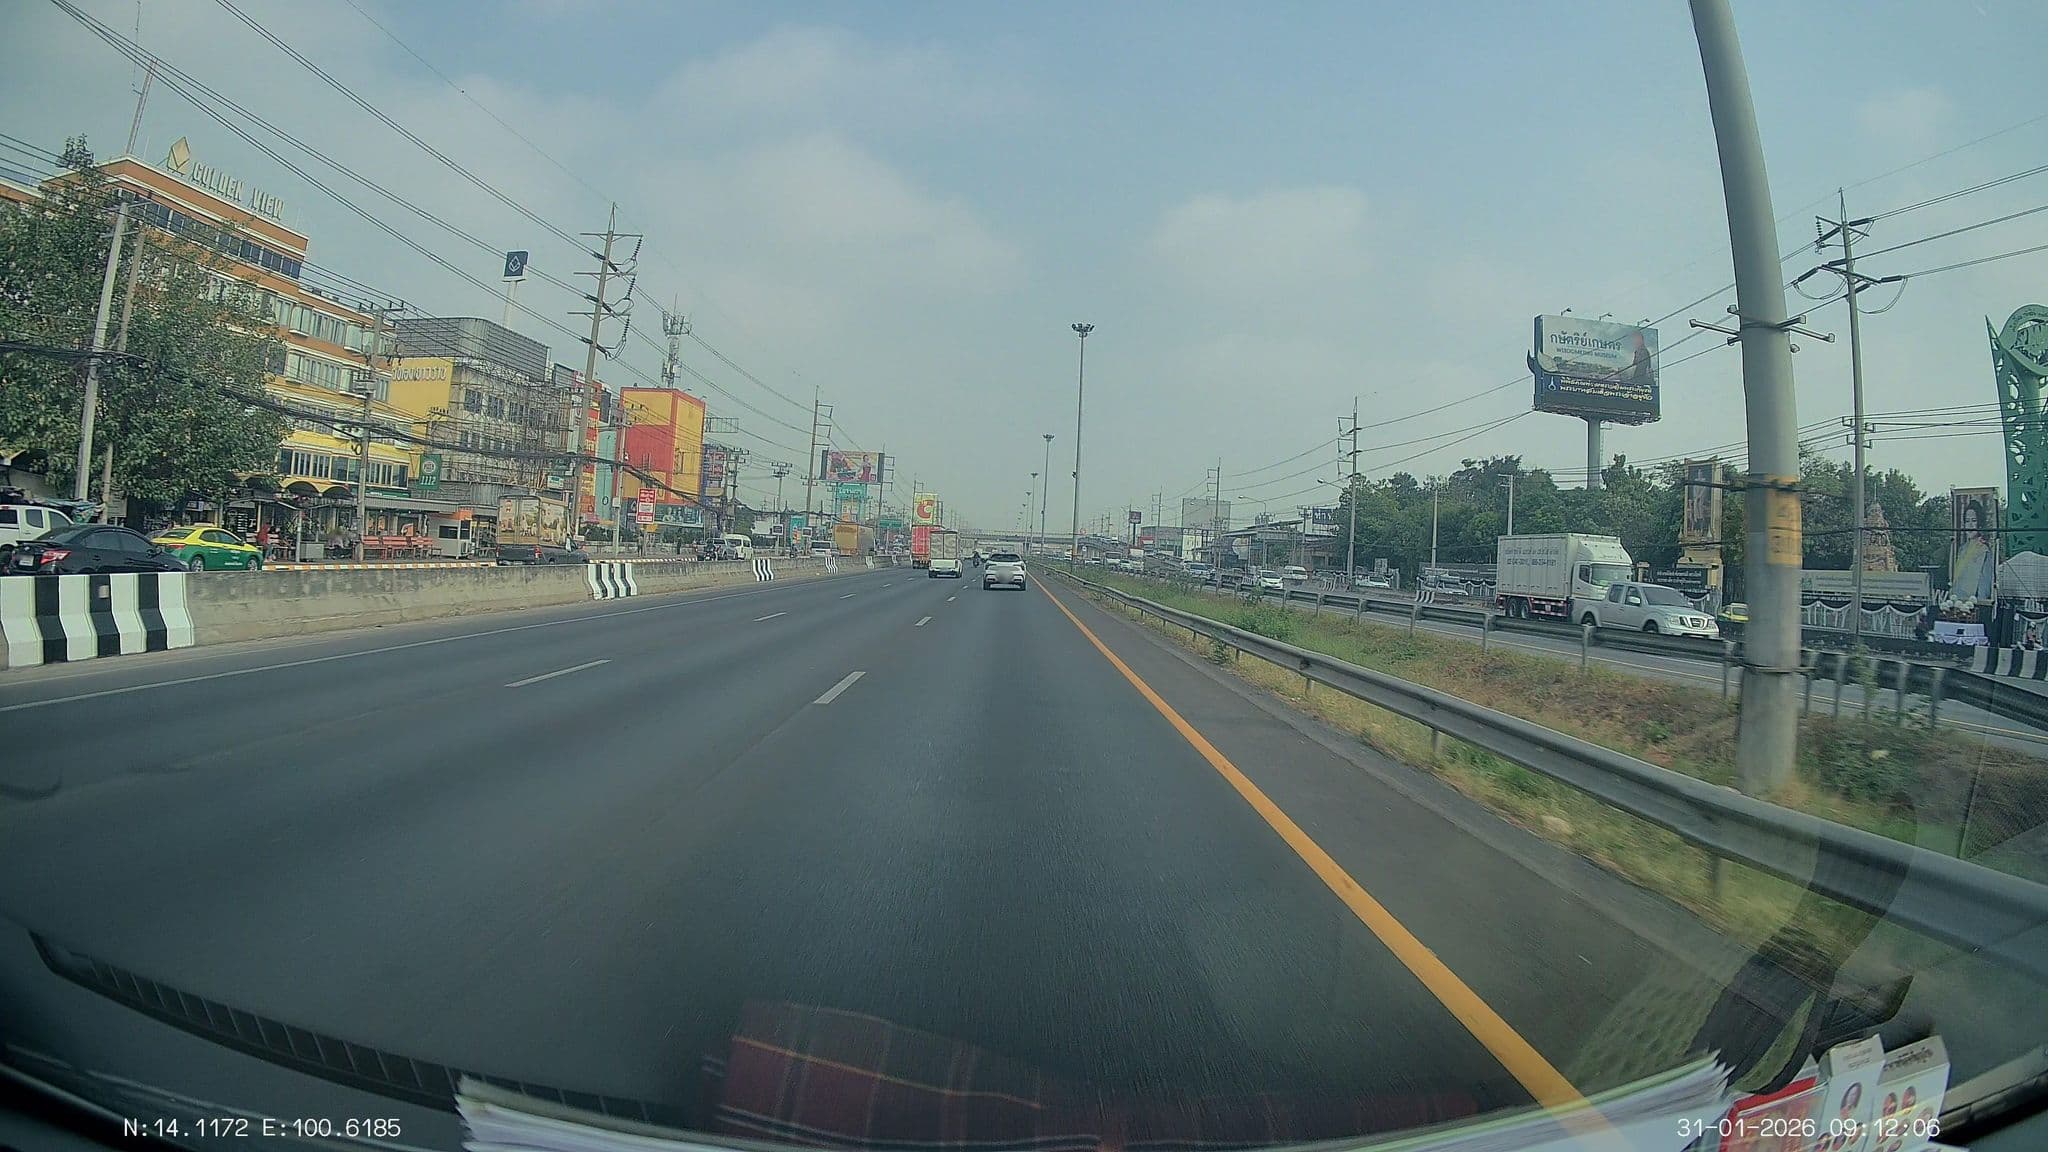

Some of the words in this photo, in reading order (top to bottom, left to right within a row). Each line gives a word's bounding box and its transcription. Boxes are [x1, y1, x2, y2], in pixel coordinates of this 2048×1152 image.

[192, 162, 244, 200] GOLDEN
[253, 189, 284, 219] VIEW
[419, 475, 437, 486] 1112
